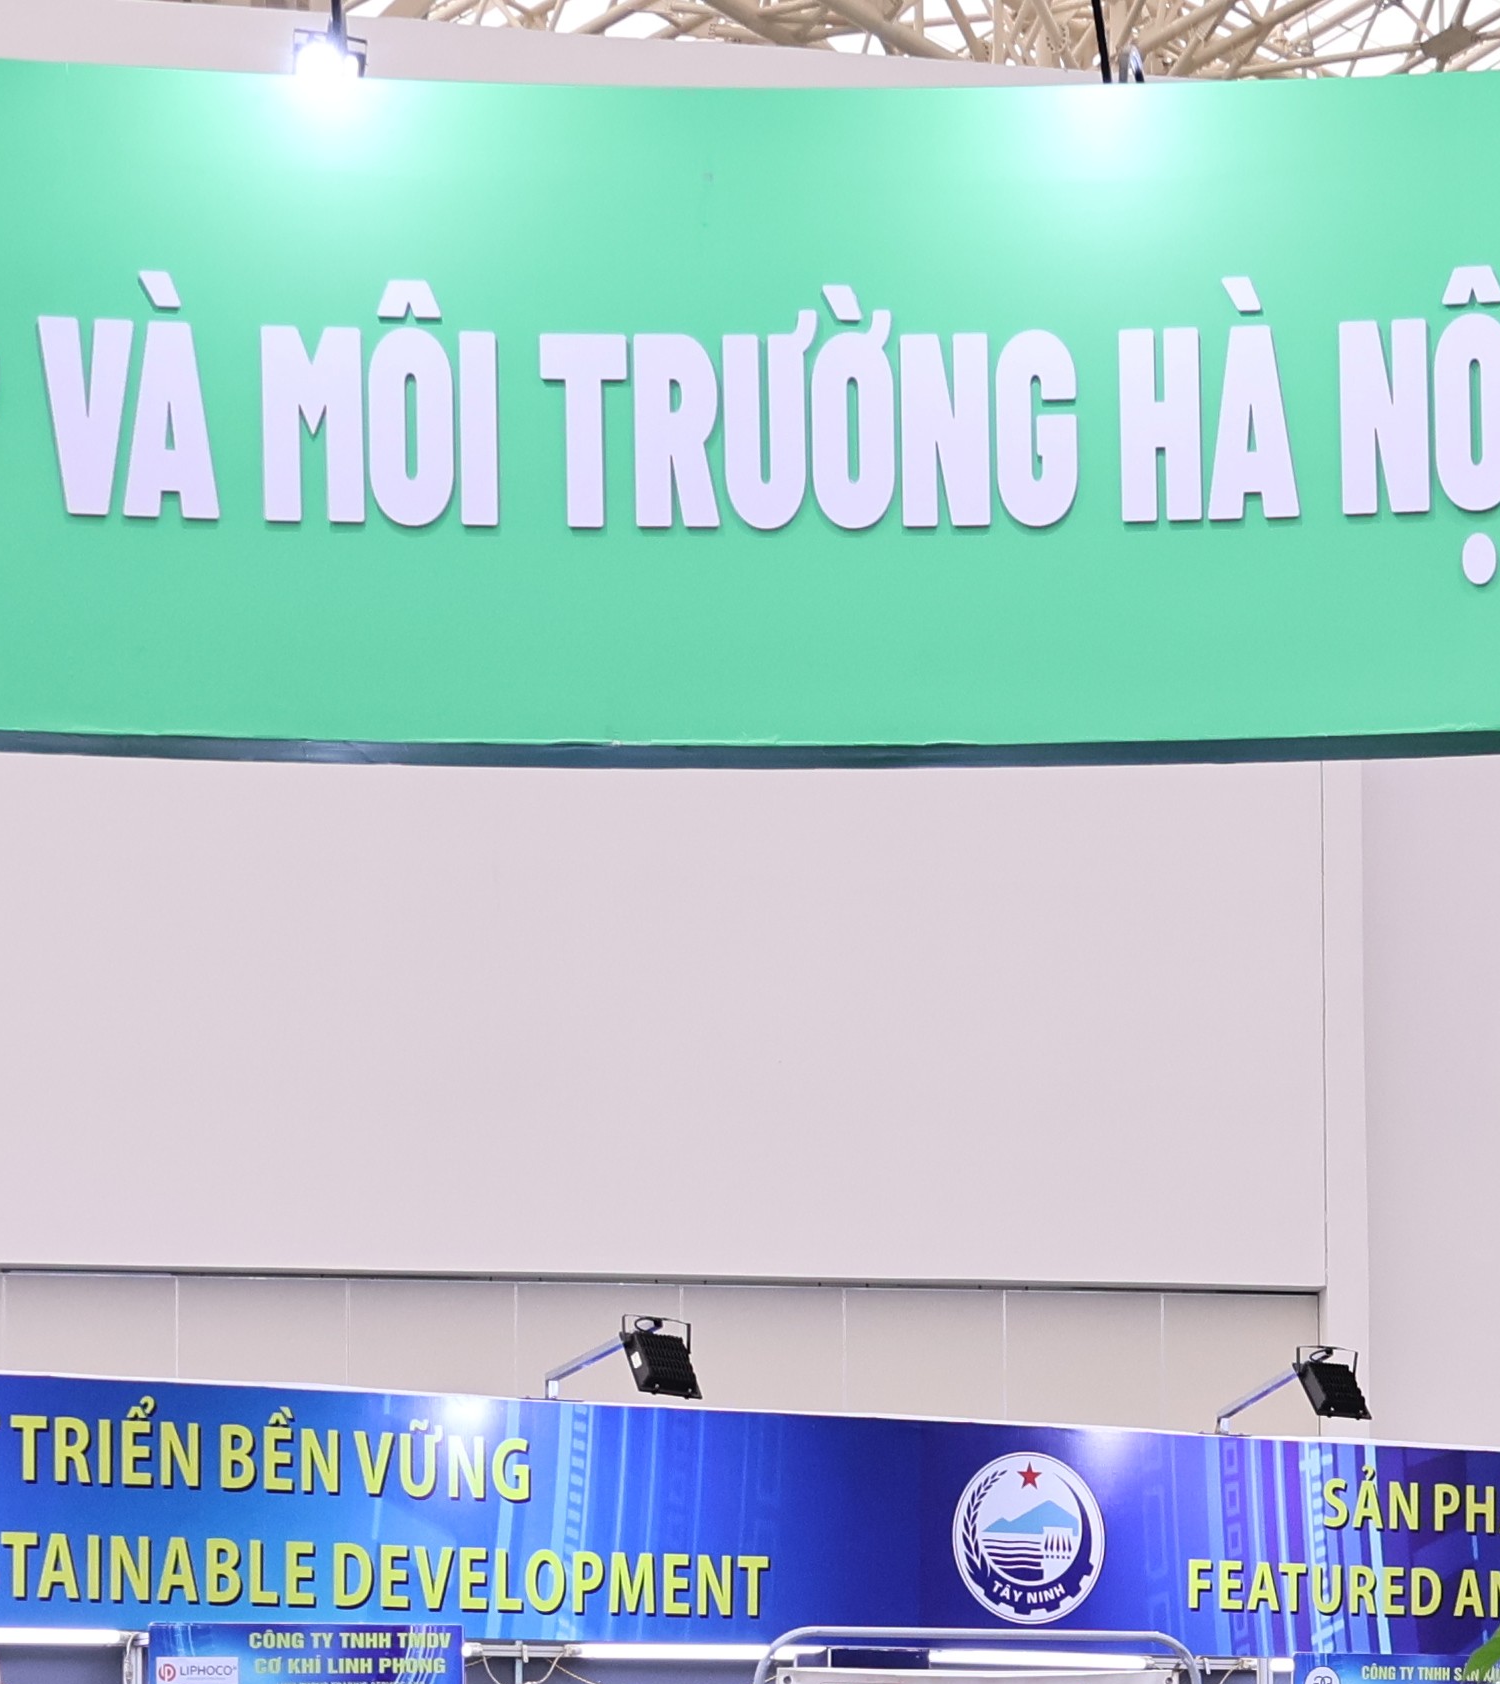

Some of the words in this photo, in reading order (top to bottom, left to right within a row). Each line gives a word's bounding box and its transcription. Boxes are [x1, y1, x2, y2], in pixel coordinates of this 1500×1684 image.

[37, 270, 220, 520] VÀ
[260, 279, 498, 528] MÔI
[538, 284, 1079, 530] TRƯỜNG
[1117, 276, 1301, 523] HÀ
[11, 1395, 200, 1490] TRIỂN
[220, 1405, 341, 1498] BỀN
[352, 1418, 532, 1504] VỮNG
[1322, 1463, 1422, 1532] SẢN
[332, 1541, 772, 1618] DEVELOPMENT
[991, 1579, 1023, 1606] TÂY
[1026, 1581, 1069, 1607] NINH
[1187, 1557, 1443, 1620] FEATURED
[249, 1629, 304, 1648] CÔNG
[310, 1633, 333, 1648] TY
[339, 1633, 391, 1648] TNHH
[396, 1633, 451, 1649] TMDV
[180, 1665, 232, 1677] LIPHOCO
[254, 1657, 283, 1674] CƠ
[288, 1654, 321, 1674] KHÍ
[328, 1658, 373, 1673] LINH
[379, 1657, 446, 1674] PHONG
[1361, 1662, 1396, 1680] CÔNG
[1399, 1666, 1414, 1680] TY
[1417, 1667, 1450, 1681] TNHH
